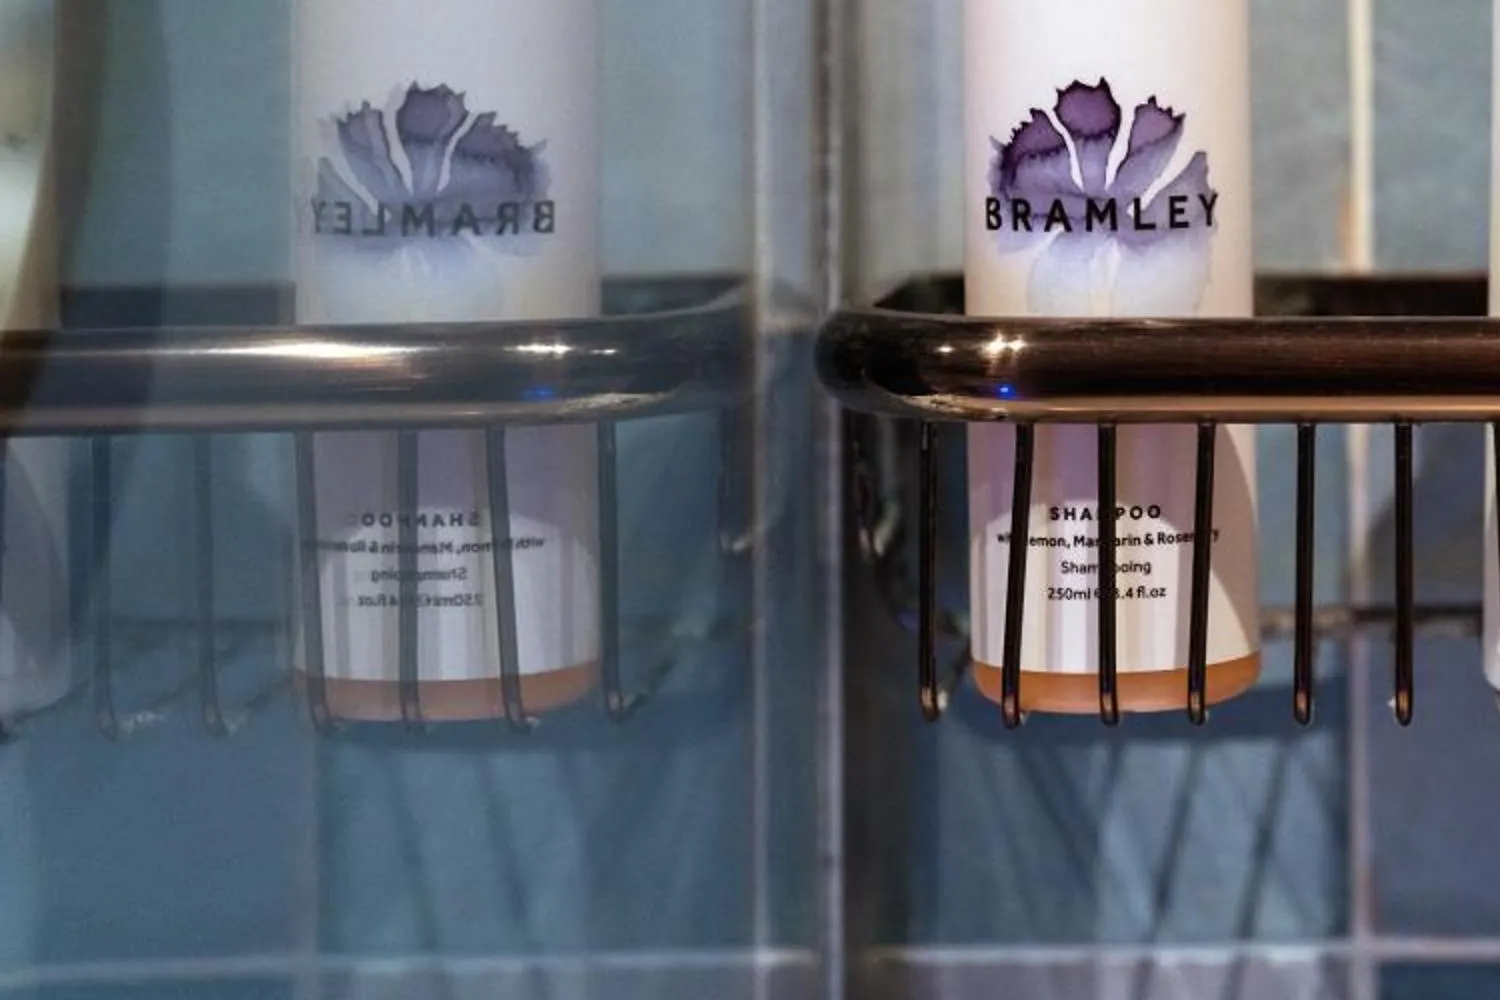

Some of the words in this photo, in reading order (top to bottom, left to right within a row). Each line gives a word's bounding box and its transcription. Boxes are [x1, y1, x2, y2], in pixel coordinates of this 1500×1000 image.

[985, 193, 1218, 232] BRAMLEY
[1049, 505, 1161, 520] SHAPOO
[1028, 535, 1071, 548] emon,
[1073, 535, 1141, 547] Maarin
[1143, 533, 1155, 547] &
[1157, 530, 1219, 545] Rosey
[1060, 561, 1152, 575] Shamoing
[1047, 587, 1092, 600] 250ml
